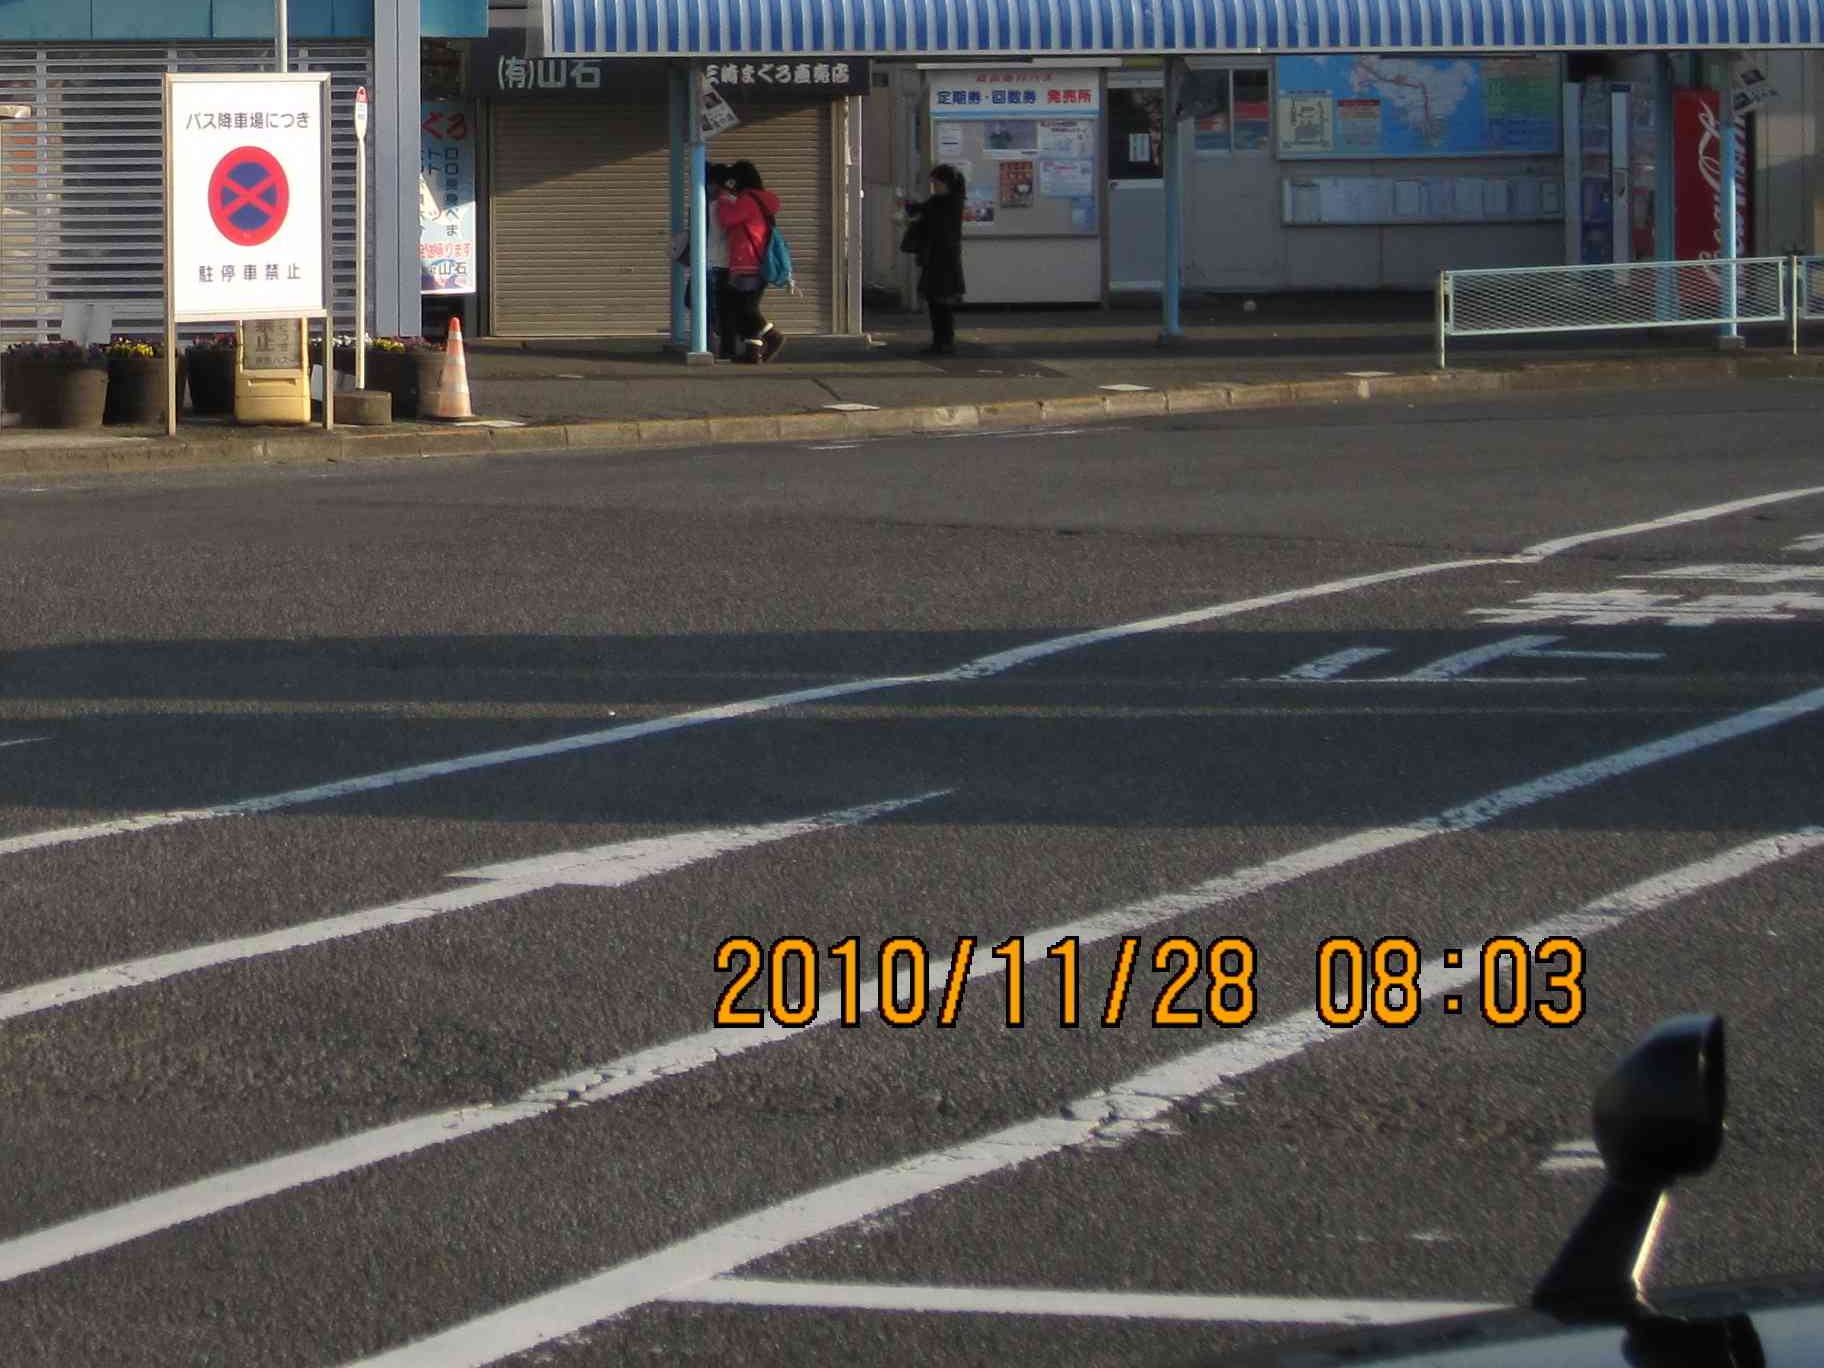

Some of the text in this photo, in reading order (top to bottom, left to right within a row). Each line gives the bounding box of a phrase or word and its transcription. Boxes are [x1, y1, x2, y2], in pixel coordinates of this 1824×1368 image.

[185, 111, 311, 130] バス降車場につき
[198, 263, 302, 283] 駐停車禁止
